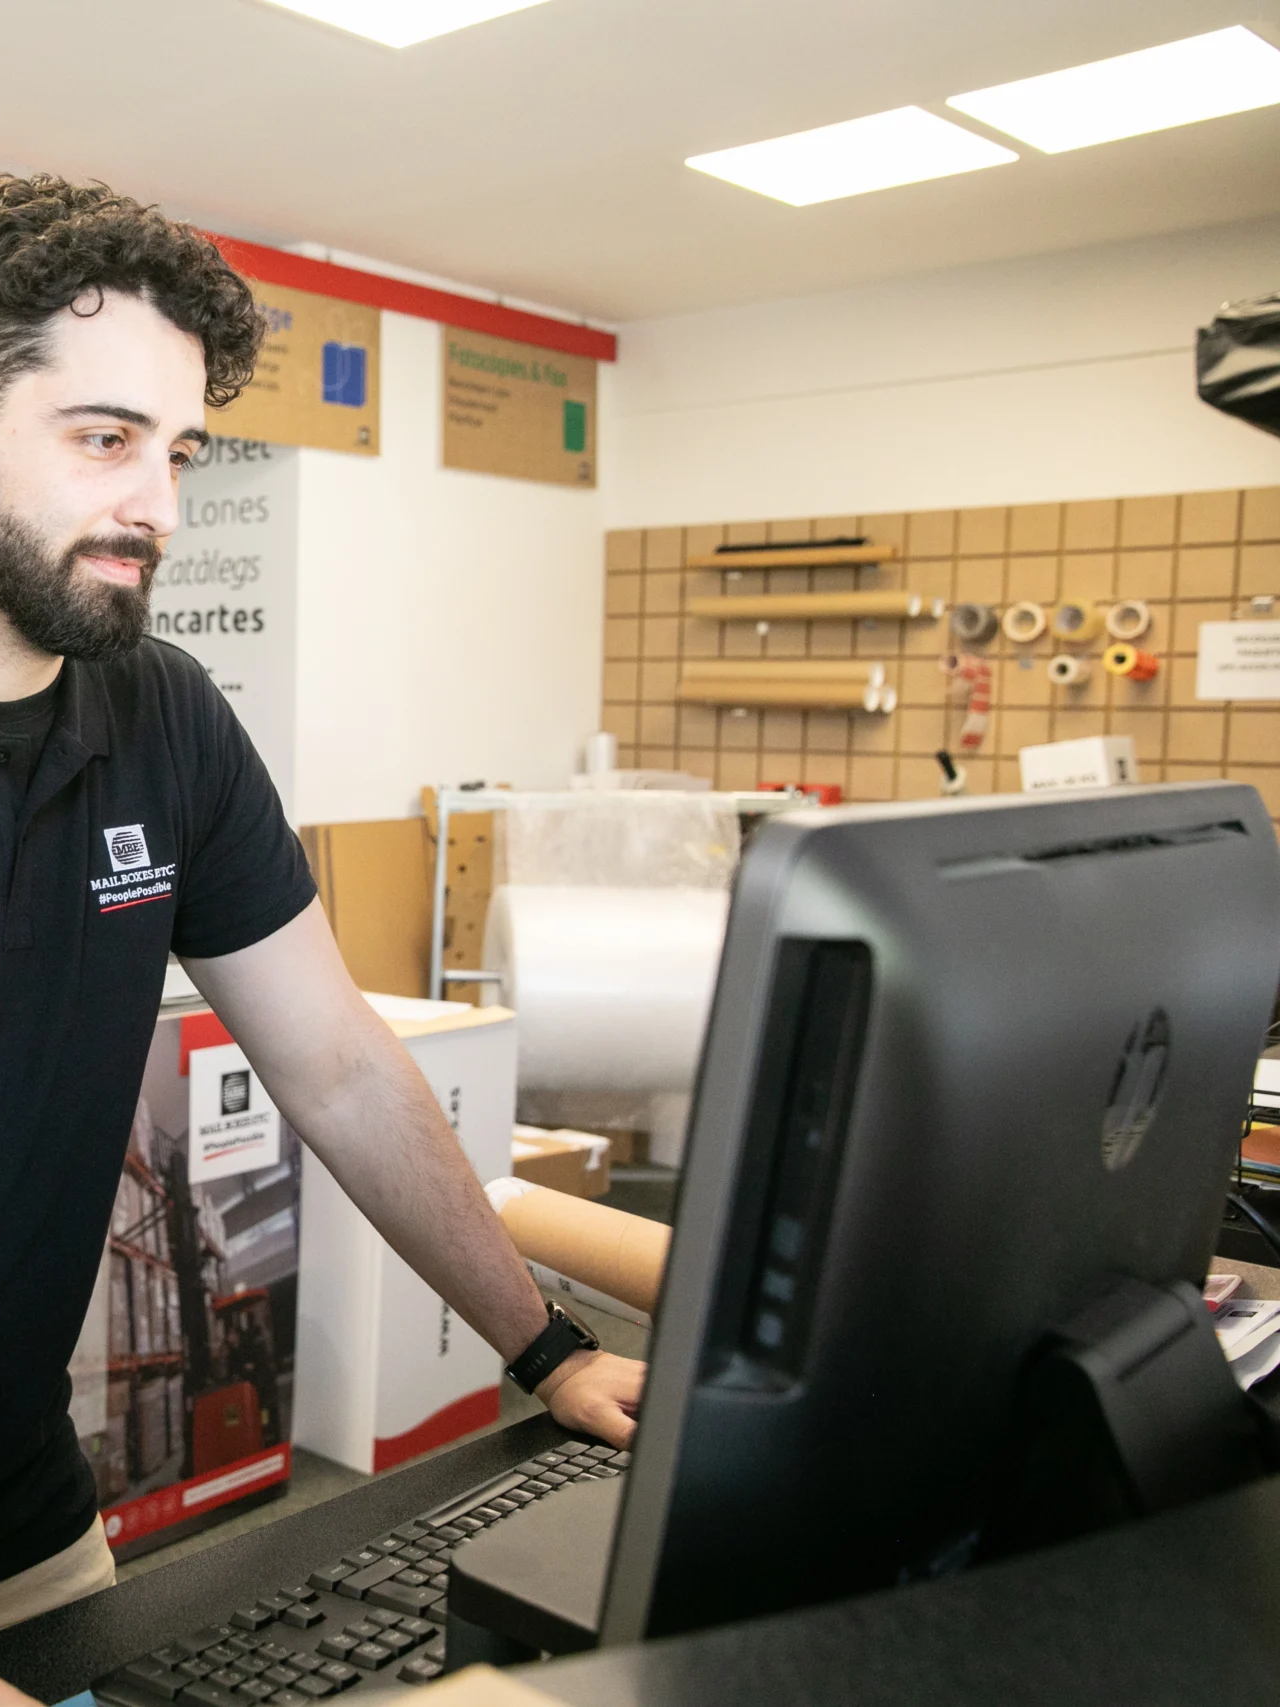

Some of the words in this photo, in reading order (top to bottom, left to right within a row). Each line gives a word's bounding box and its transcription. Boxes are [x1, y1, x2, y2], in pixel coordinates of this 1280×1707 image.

[186, 495, 269, 529] Lones
[150, 604, 265, 635] ncartes
[115, 842, 140, 855] MBE
[89, 875, 121, 891] MAIL
[120, 869, 154, 885] BOXES
[98, 881, 172, 905] #PeoplePossible
